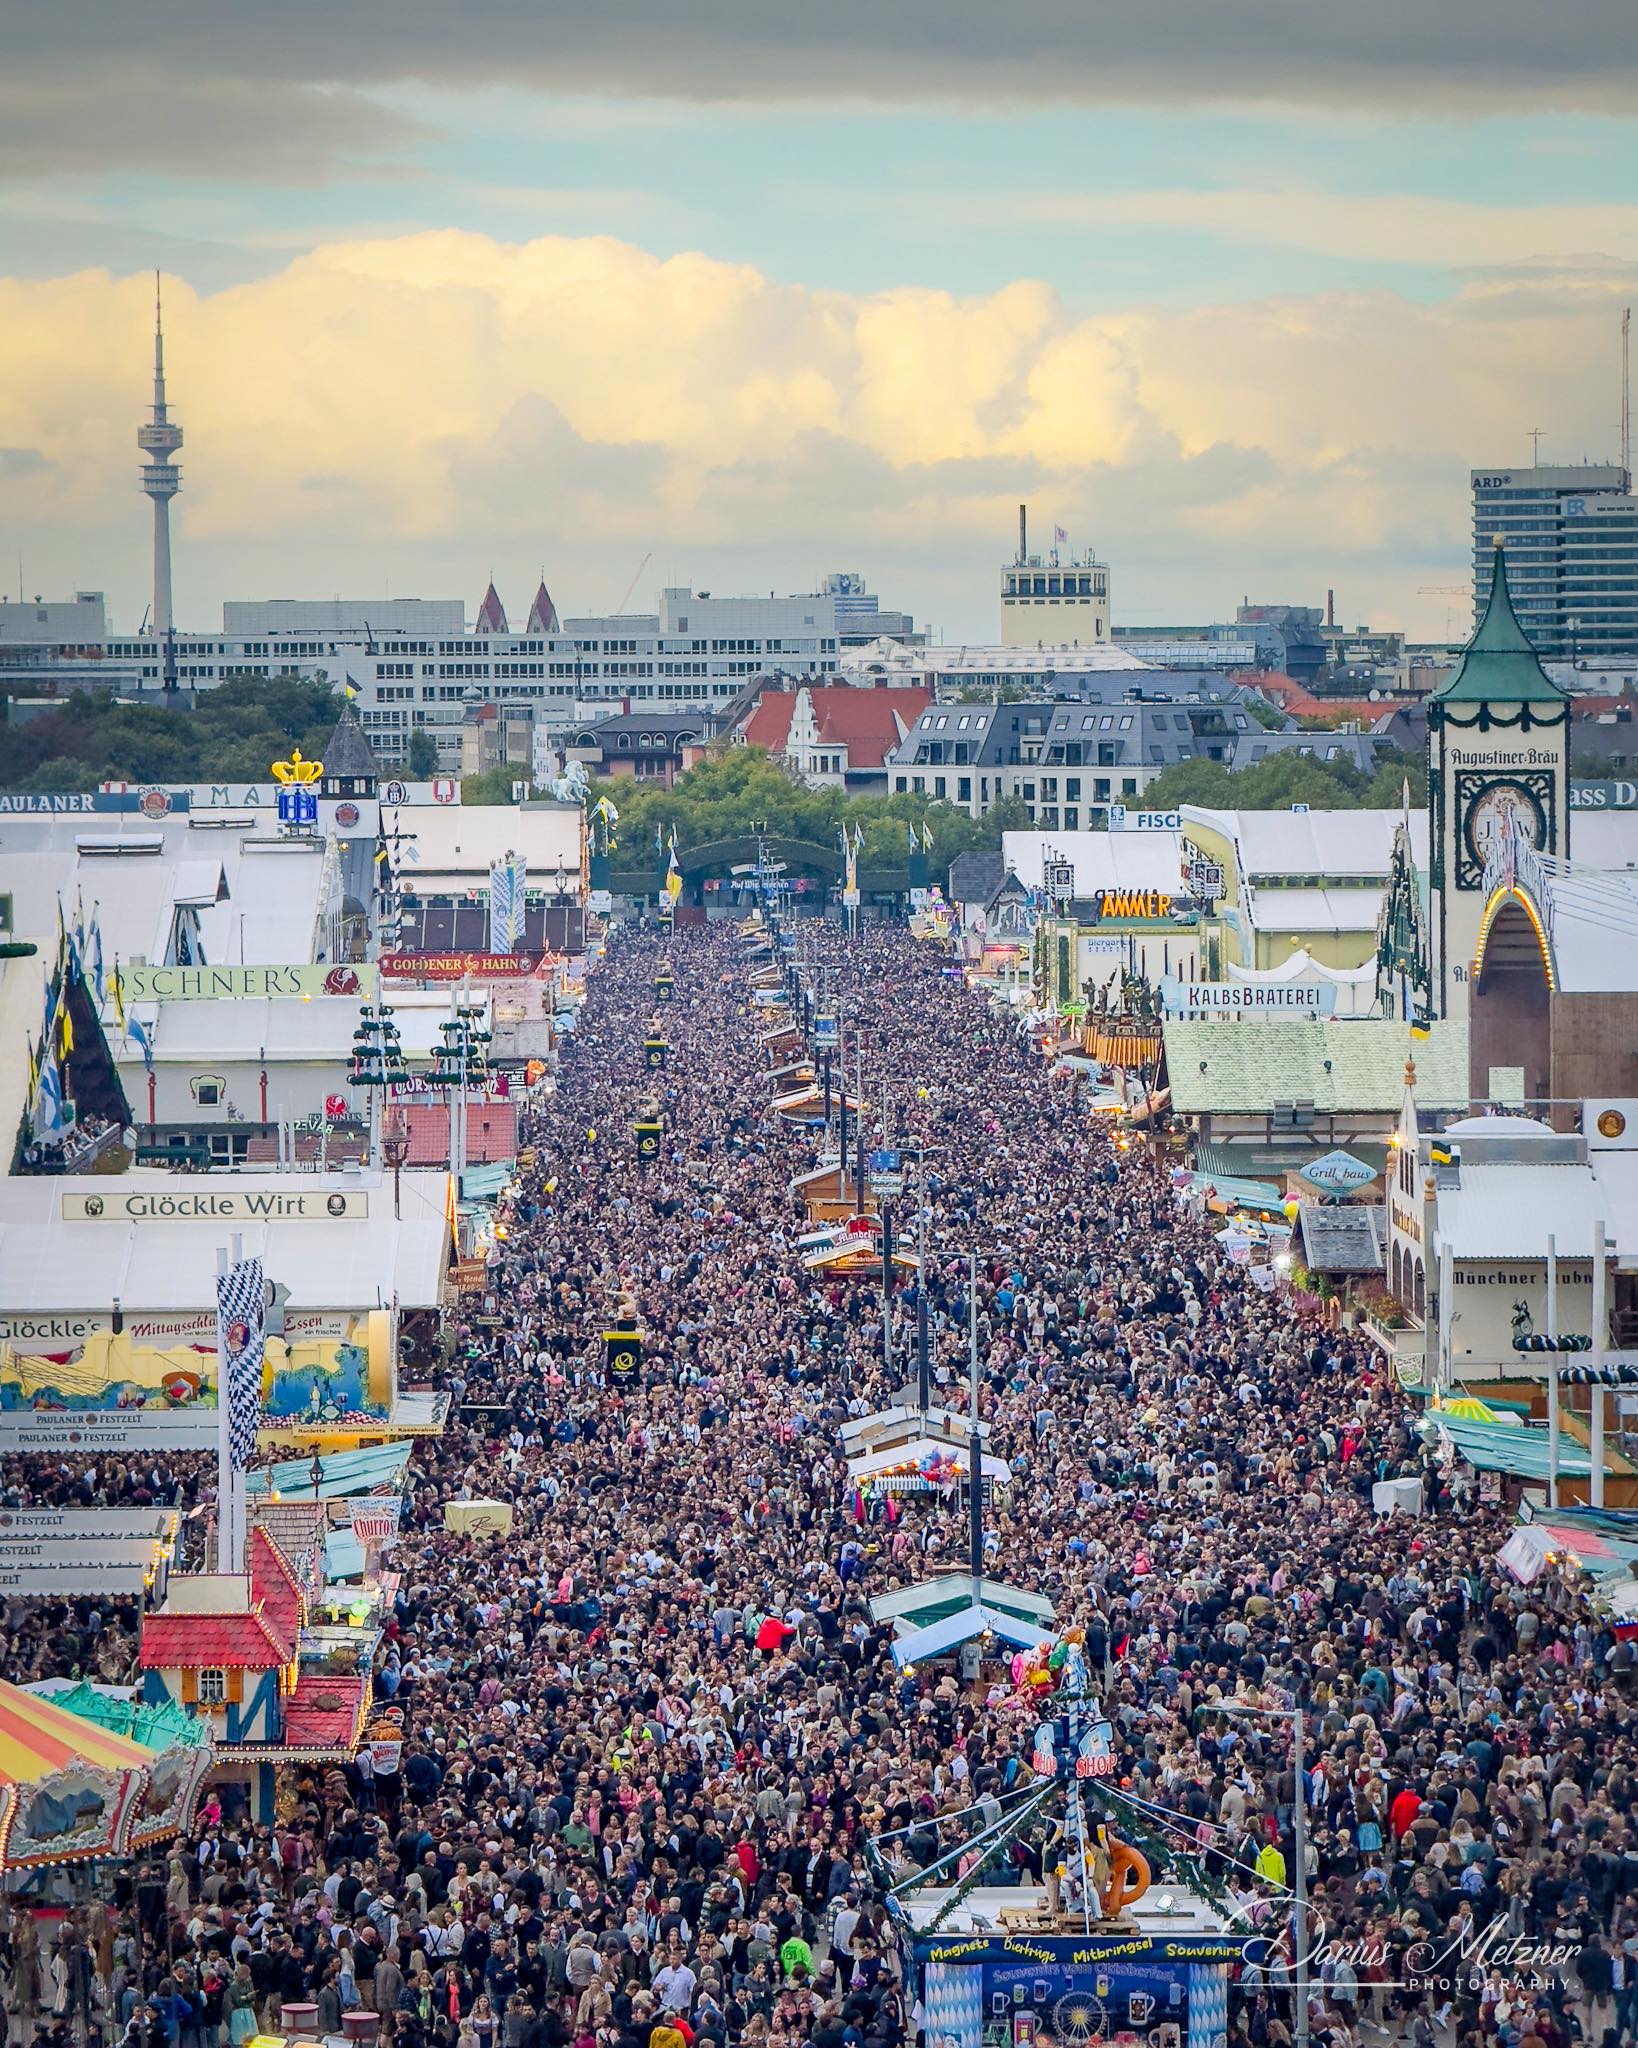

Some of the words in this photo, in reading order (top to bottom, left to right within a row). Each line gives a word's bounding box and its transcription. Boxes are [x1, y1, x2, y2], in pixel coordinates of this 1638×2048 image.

[1473, 477, 1502, 488] ARD
[1101, 895, 1171, 917] AMMER
[482, 957, 520, 969] HAHN
[1309, 1167, 1336, 1178] Grill
[1343, 1168, 1371, 1179] haus
[125, 1195, 234, 1216] Glöckle
[244, 1195, 306, 1214] Wirt
[284, 1315, 322, 1331] Essen
[36, 1415, 84, 1424] PAULANER
[100, 1415, 143, 1423] FESTZELT
[18, 1433, 68, 1442] PAULANER
[84, 1433, 128, 1442] FESTZELT
[15, 1516, 64, 1525] FESTZELT
[353, 1518, 395, 1538] Churros
[1033, 1750, 1057, 1777] SHOP
[1076, 1753, 1118, 1778] SHOP
[930, 1939, 990, 1961] Magnete
[1073, 1938, 1153, 1964] Mitbringsel
[1167, 1944, 1241, 1957] Souvenirs
